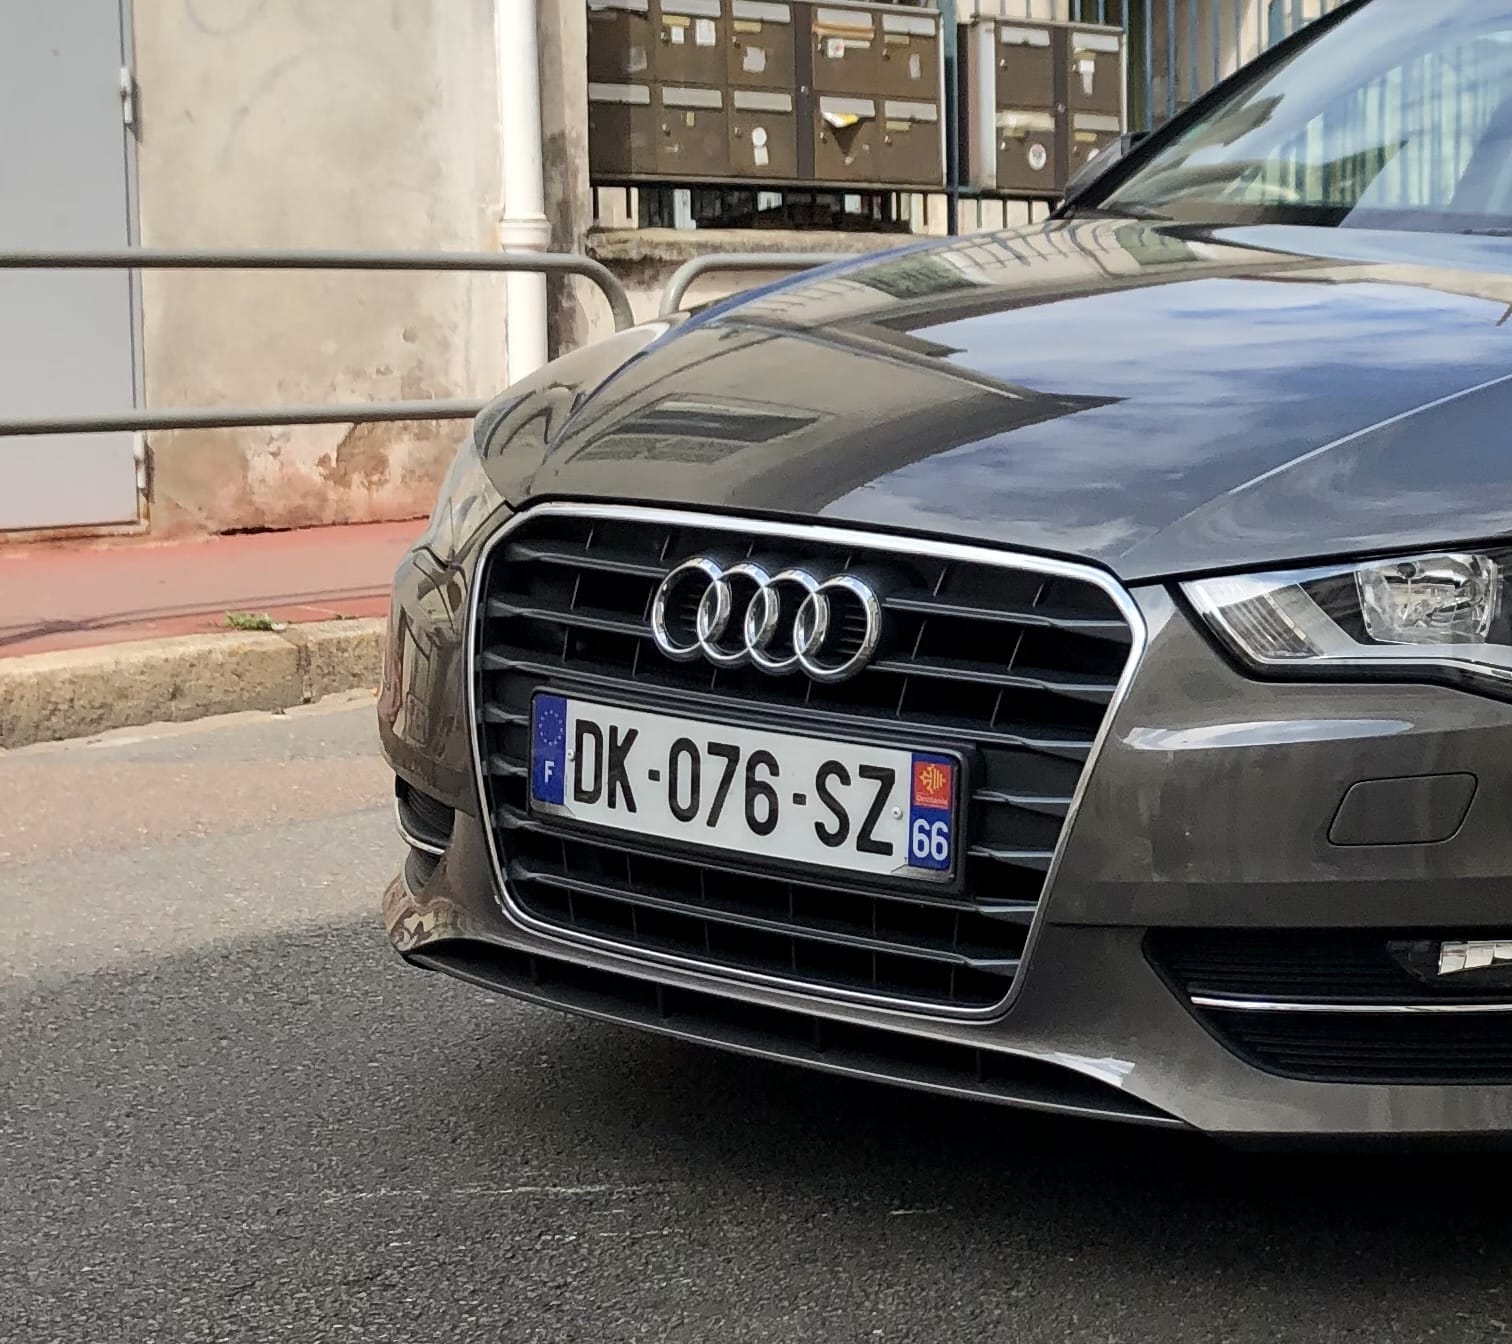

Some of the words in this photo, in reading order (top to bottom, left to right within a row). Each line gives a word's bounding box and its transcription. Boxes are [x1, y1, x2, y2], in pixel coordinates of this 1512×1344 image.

[544, 760, 555, 784] F
[573, 719, 896, 857] DK-076-SZ
[912, 818, 949, 861] 66
